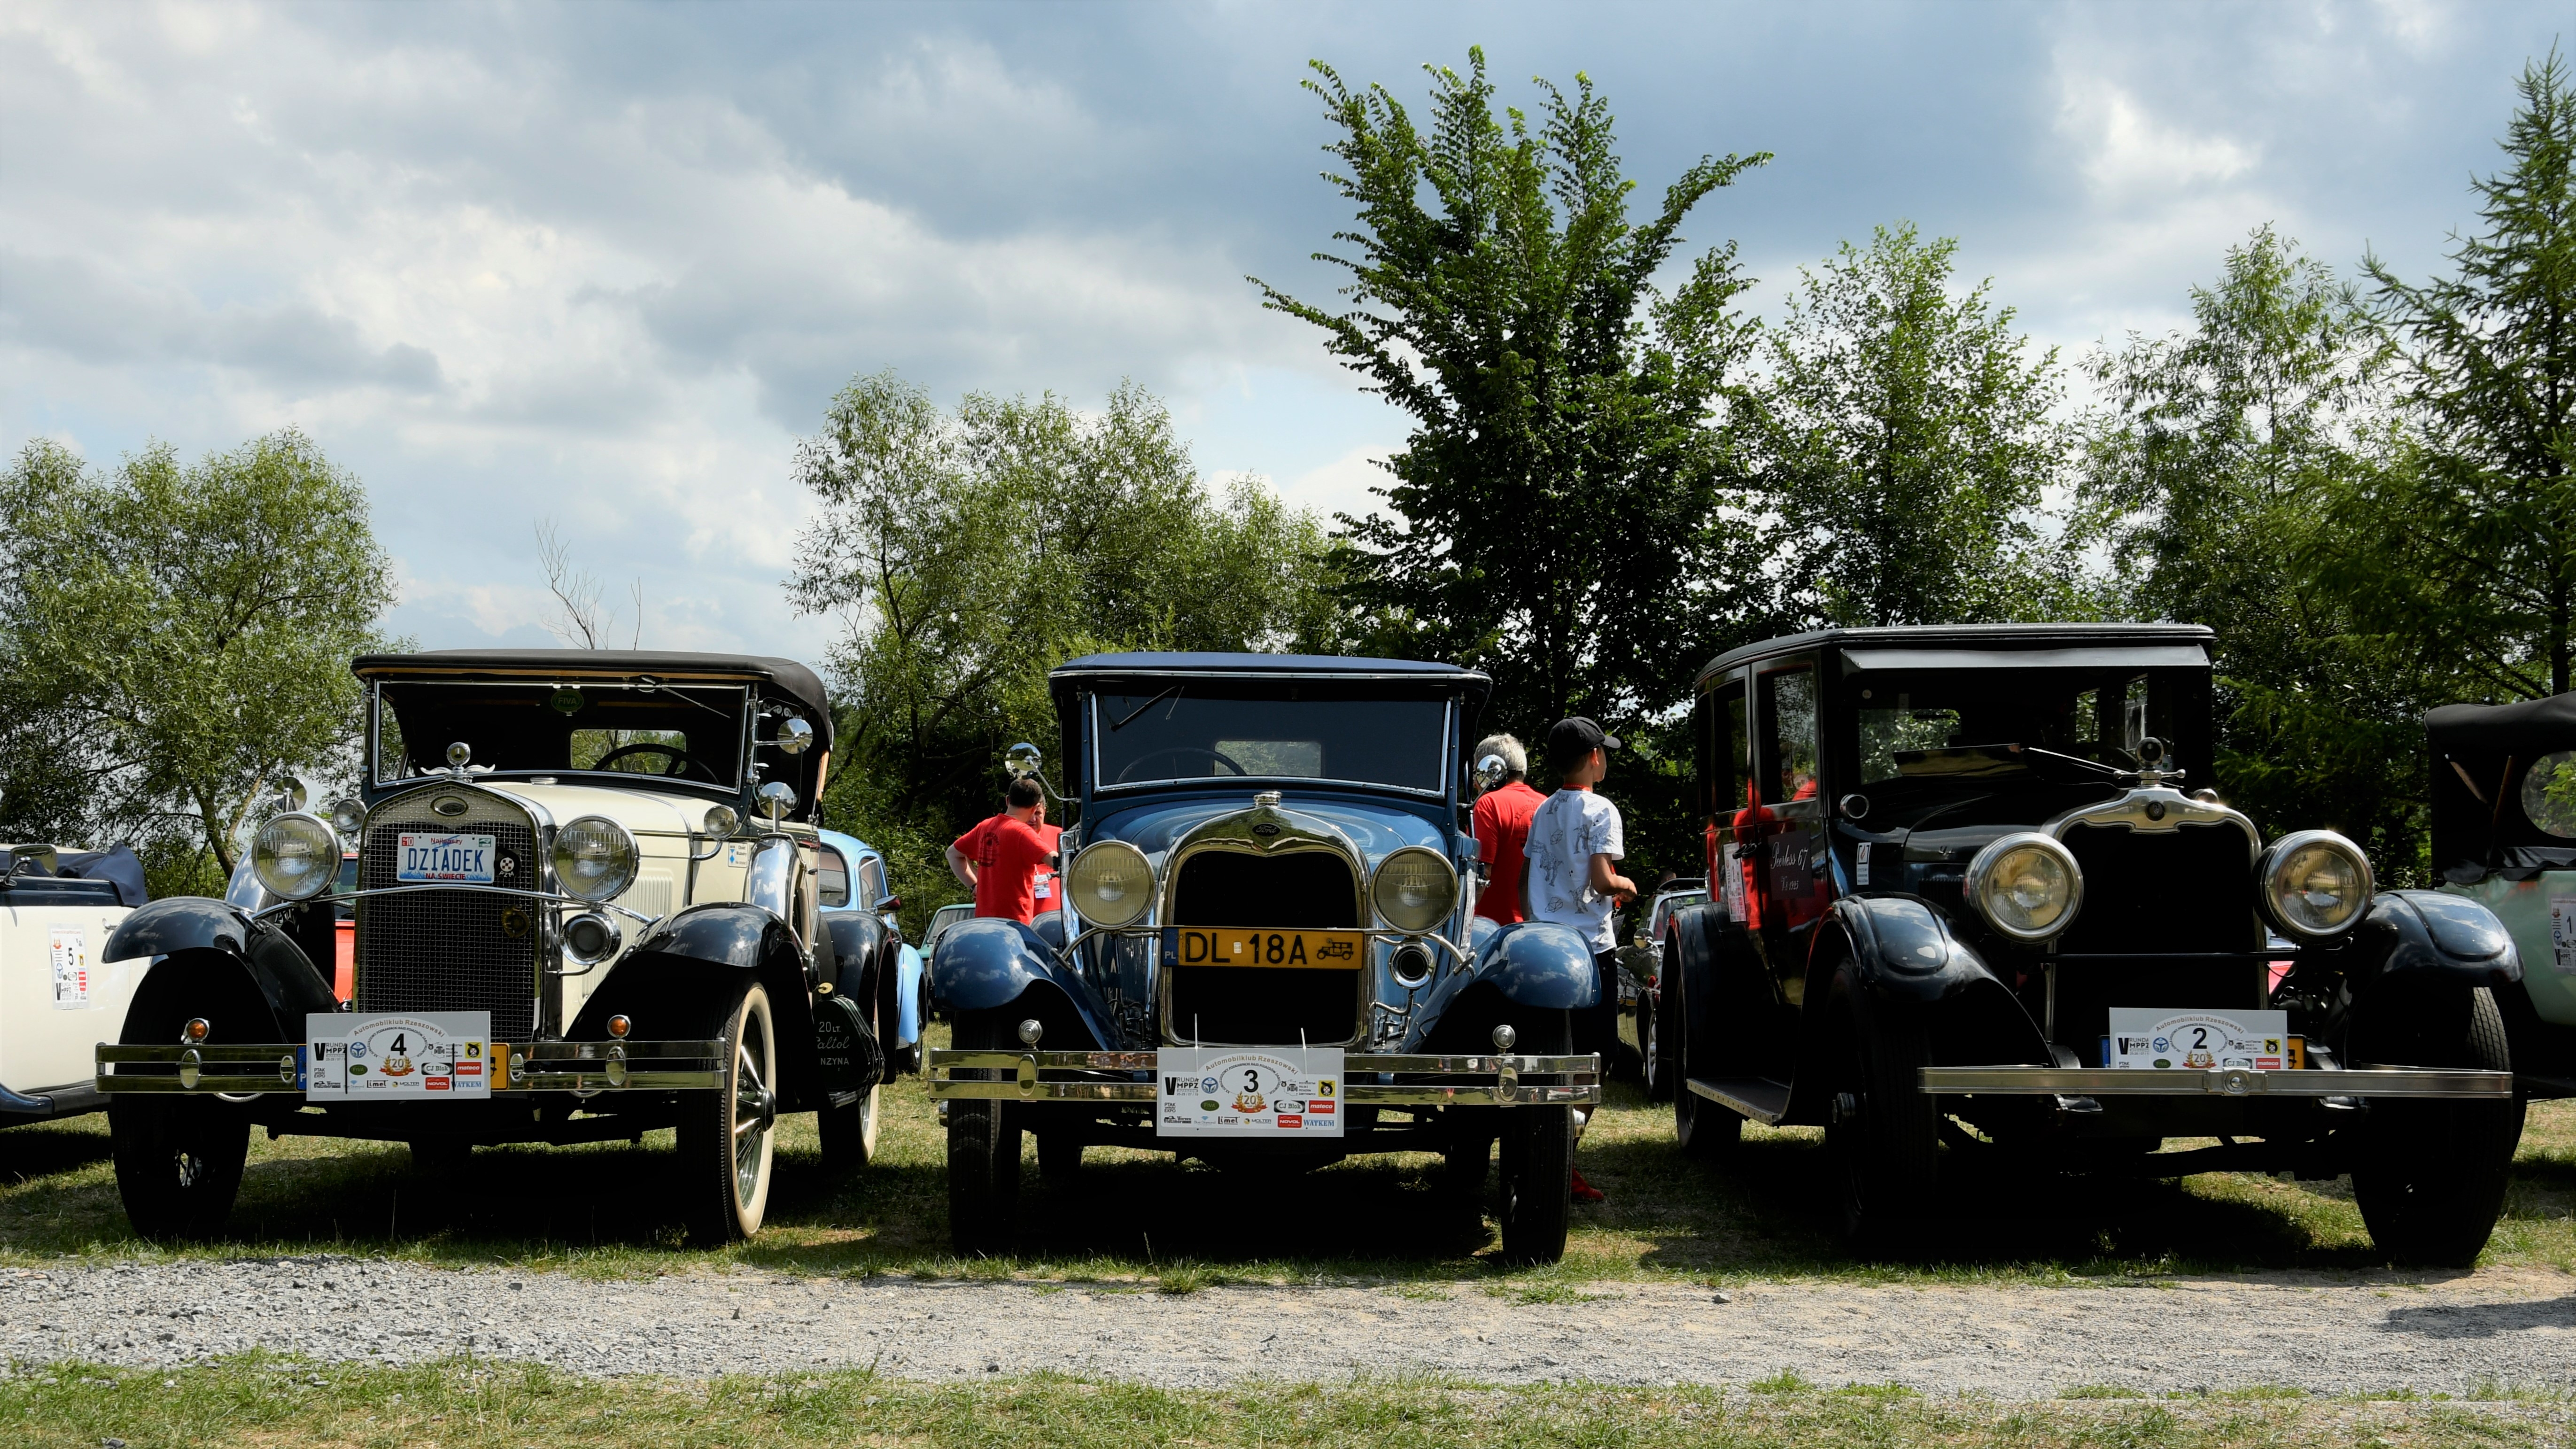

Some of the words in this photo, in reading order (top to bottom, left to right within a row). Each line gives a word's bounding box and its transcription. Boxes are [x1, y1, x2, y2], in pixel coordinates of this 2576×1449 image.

[1256, 825, 1277, 833] Ford
[408, 848, 483, 872] DZIADEK
[1770, 841, 1796, 869] Peerless
[1798, 847, 1808, 871] 67
[2567, 916, 2572, 934] 1
[68, 947, 74, 966] 5
[1164, 951, 1176, 959] PL
[1185, 932, 1230, 962] DL
[1249, 933, 1307, 964] 18A
[2555, 949, 2560, 965] V
[56, 983, 61, 1000] V
[354, 1019, 403, 1036] Automobilklub
[405, 1019, 445, 1038] Rzeszowski
[819, 1022, 831, 1032] 20
[2156, 1016, 2204, 1032] Automobilklub
[2205, 1016, 2245, 1034] Rzeszowski
[390, 1033, 407, 1056] 4
[2118, 1038, 2129, 1054] V
[2193, 1028, 2207, 1049] 2
[314, 1043, 326, 1061] V
[2194, 1054, 2206, 1062] 20
[392, 1059, 404, 1068] 20
[1205, 1055, 1256, 1071] Automobilklub
[1258, 1055, 1298, 1075] Rzeszowski
[1164, 1077, 1177, 1095] V
[1243, 1069, 1258, 1093] 3
[1244, 1095, 1257, 1104] 20
